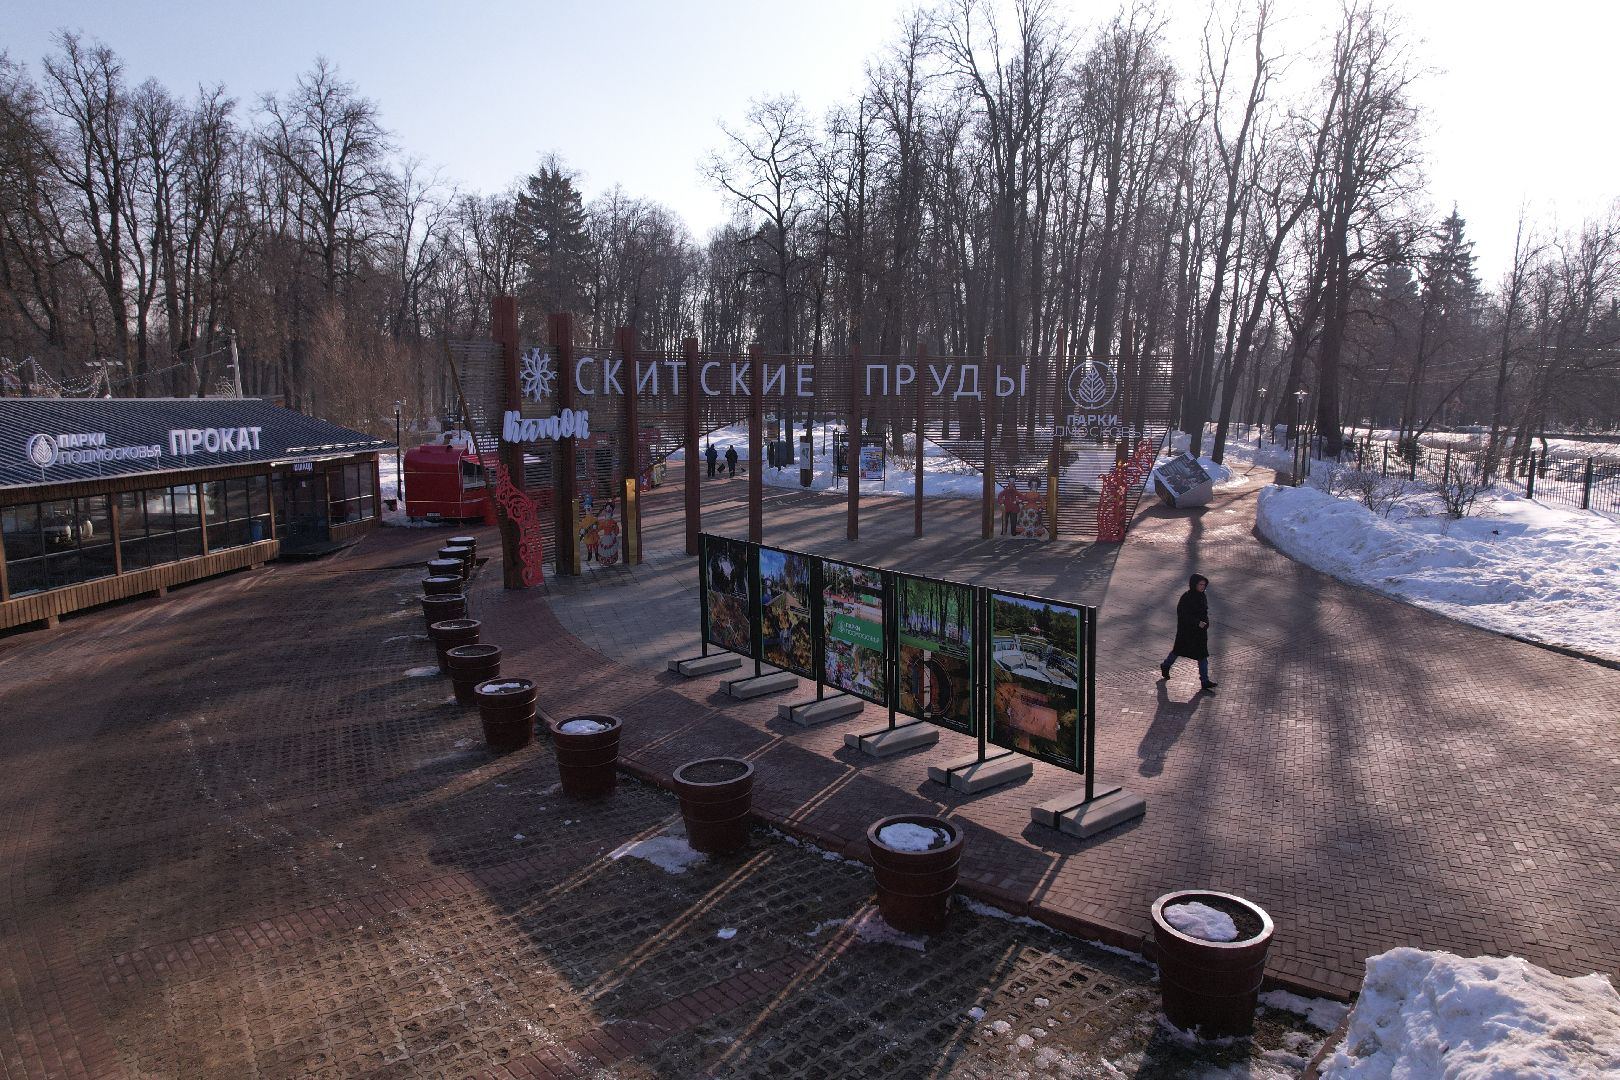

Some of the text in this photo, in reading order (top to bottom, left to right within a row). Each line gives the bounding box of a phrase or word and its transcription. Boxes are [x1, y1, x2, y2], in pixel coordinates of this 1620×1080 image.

[574, 356, 1027, 402] СКИТСКИЕ ПРУДЫ
[1066, 413, 1118, 426] ПАРКИ
[57, 432, 107, 448] ПАРКИ
[169, 426, 262, 456] ПРОКАТ
[59, 444, 162, 465] ПОДМОСКОВЬЯ
